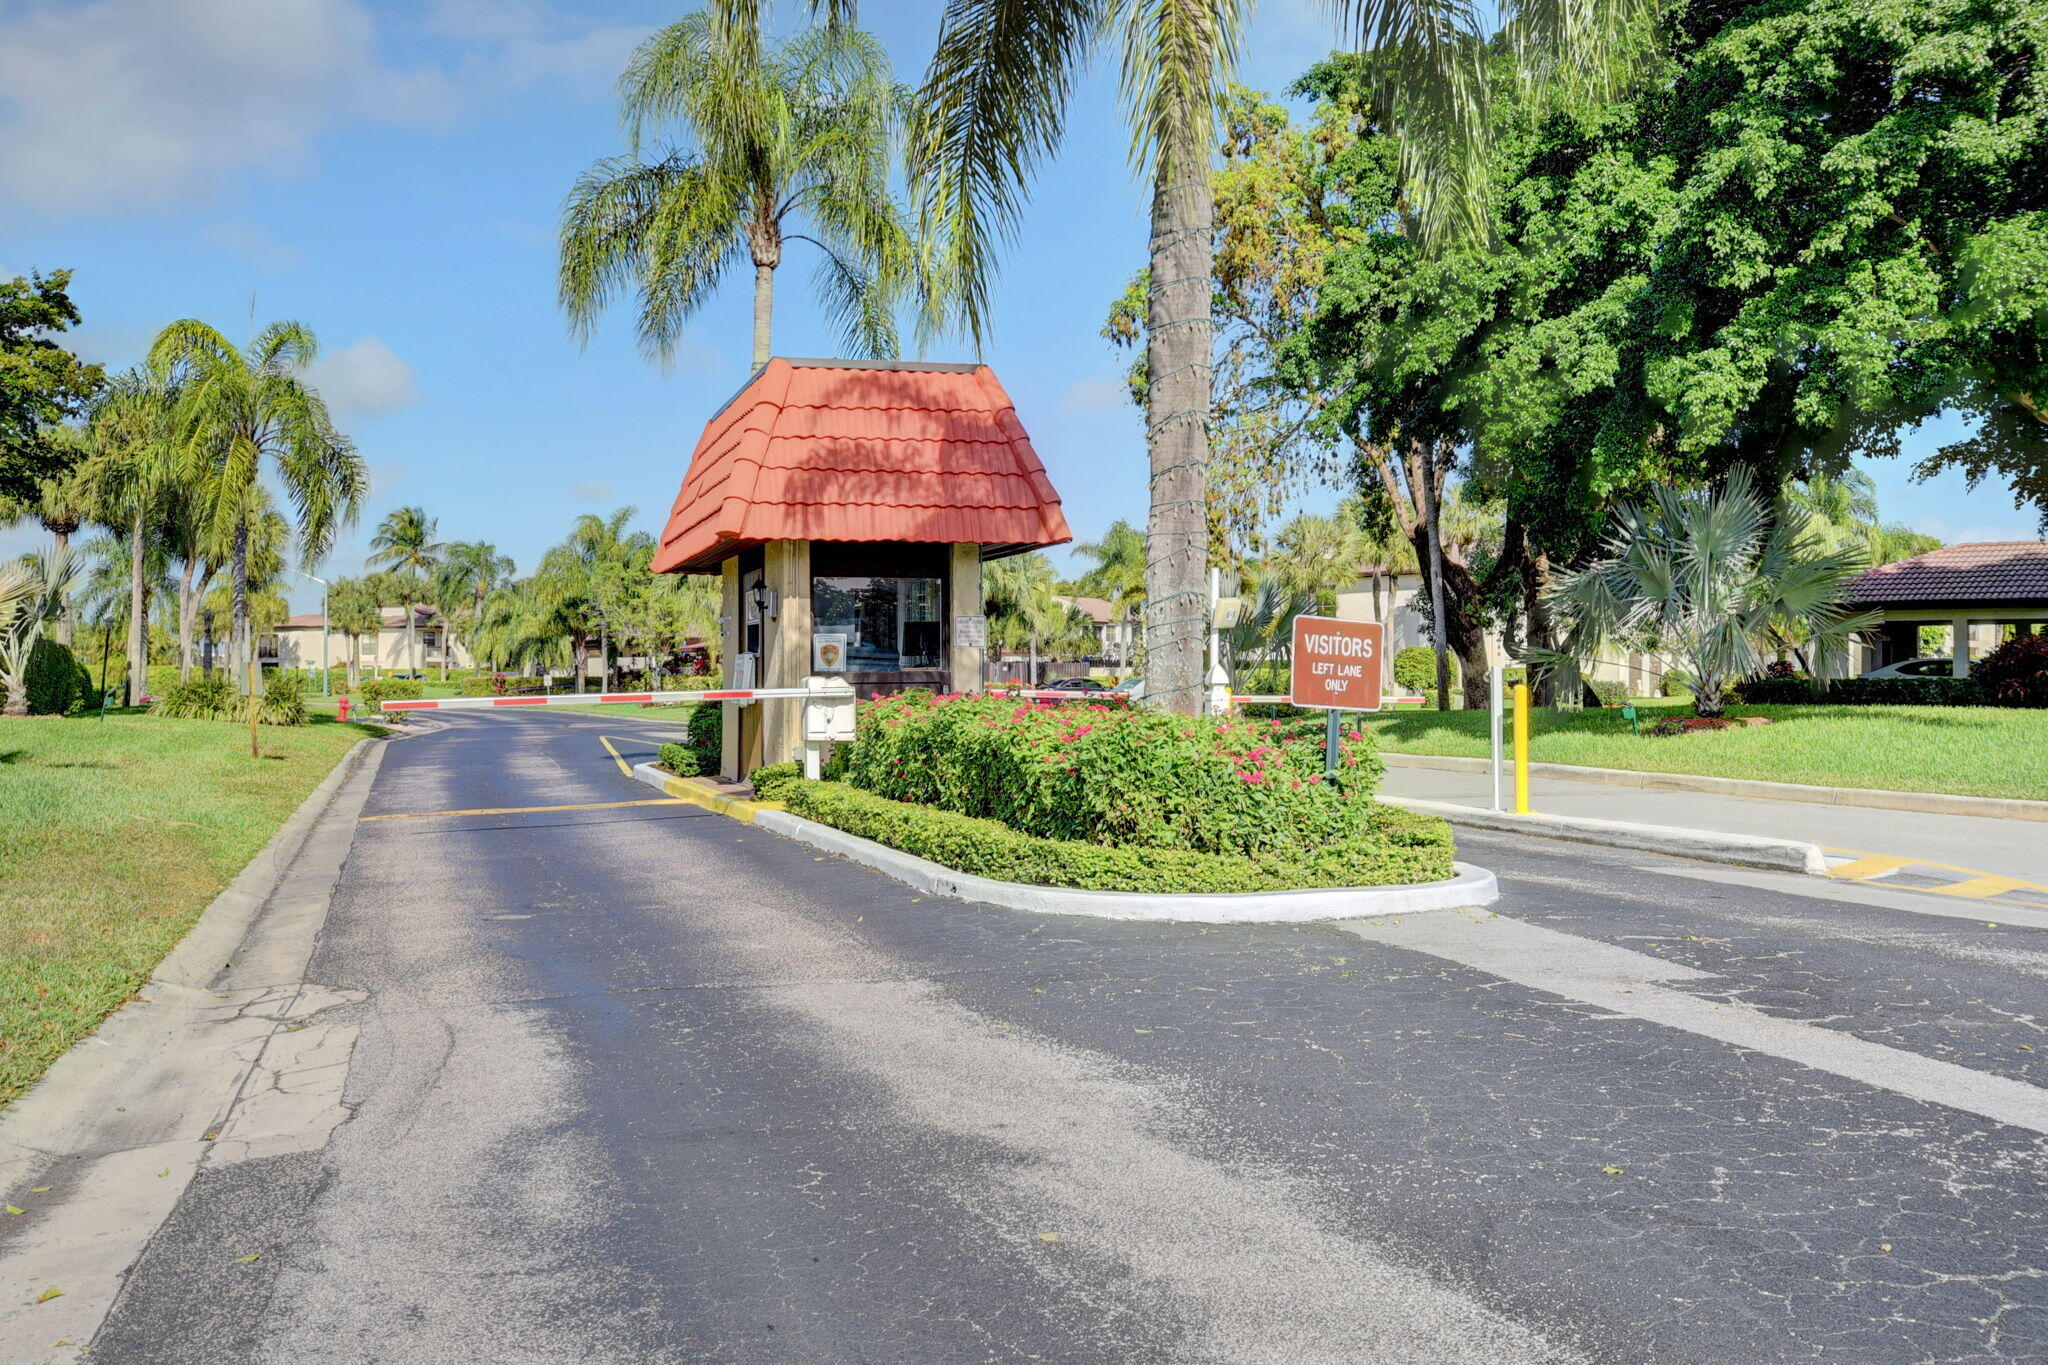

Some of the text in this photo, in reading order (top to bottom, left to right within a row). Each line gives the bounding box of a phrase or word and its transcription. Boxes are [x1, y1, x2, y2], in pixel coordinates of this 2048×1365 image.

[1304, 633, 1373, 658] VISITORS
[1312, 662, 1362, 677] LEFT LANE
[1325, 679, 1348, 691] ONLY
